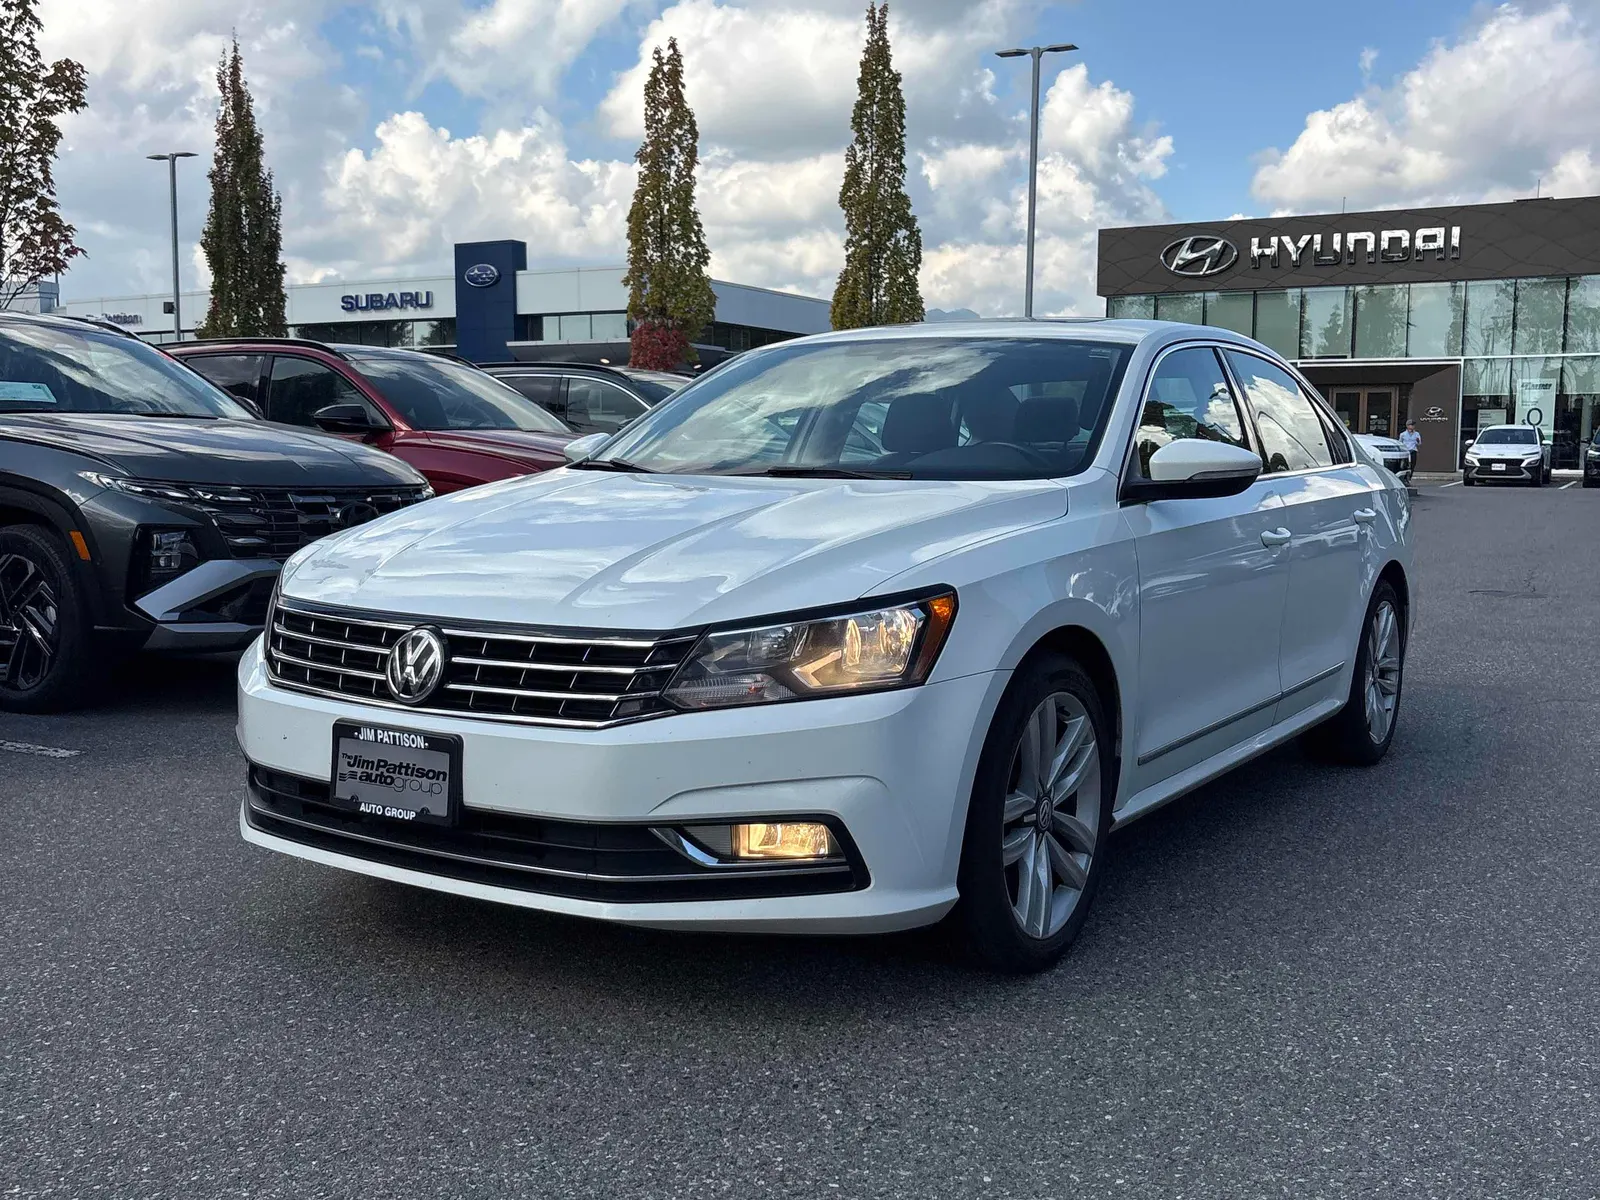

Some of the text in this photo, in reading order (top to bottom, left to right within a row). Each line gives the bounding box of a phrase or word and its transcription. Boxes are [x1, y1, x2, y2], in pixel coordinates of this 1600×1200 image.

[1250, 226, 1461, 269] HYUNDAI
[340, 291, 433, 312] SUBARU
[358, 727, 425, 749] JIM PATTISON
[359, 802, 416, 820] AUTO GROUP
